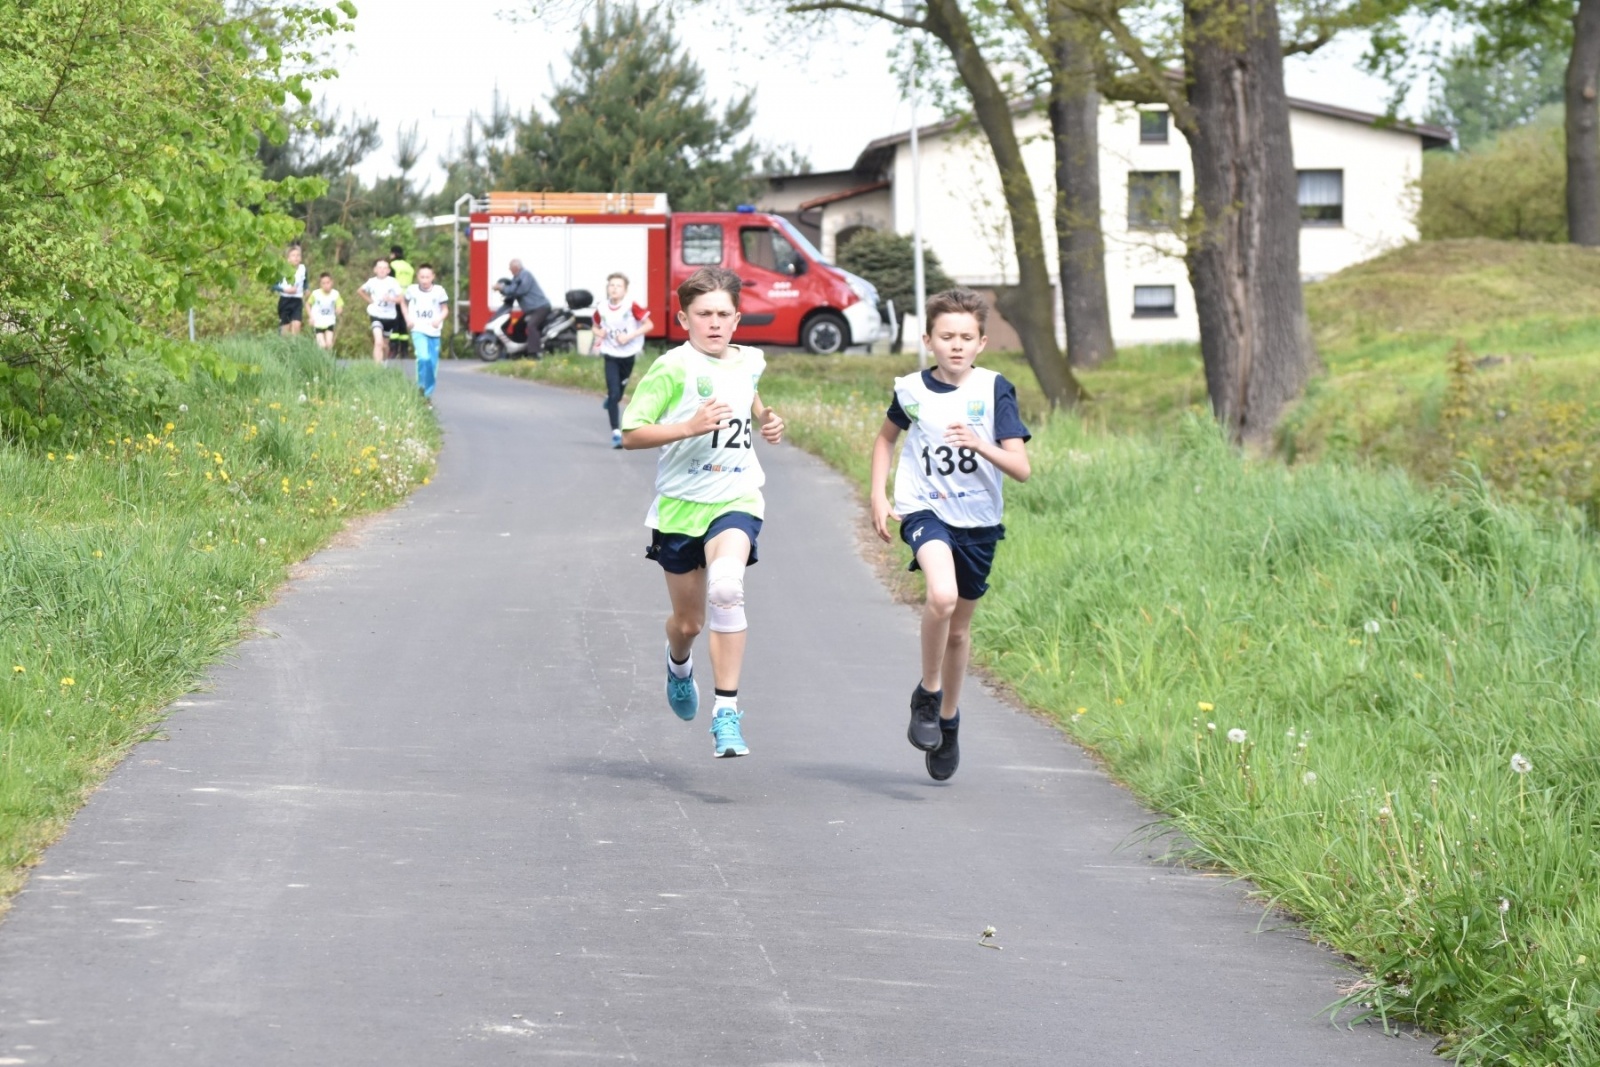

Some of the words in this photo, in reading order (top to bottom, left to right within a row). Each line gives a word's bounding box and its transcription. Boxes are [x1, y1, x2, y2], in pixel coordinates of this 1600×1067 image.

[489, 215, 568, 224] DRAGON
[416, 309, 434, 319] 140
[711, 418, 752, 449] 125
[921, 444, 979, 477] 138
